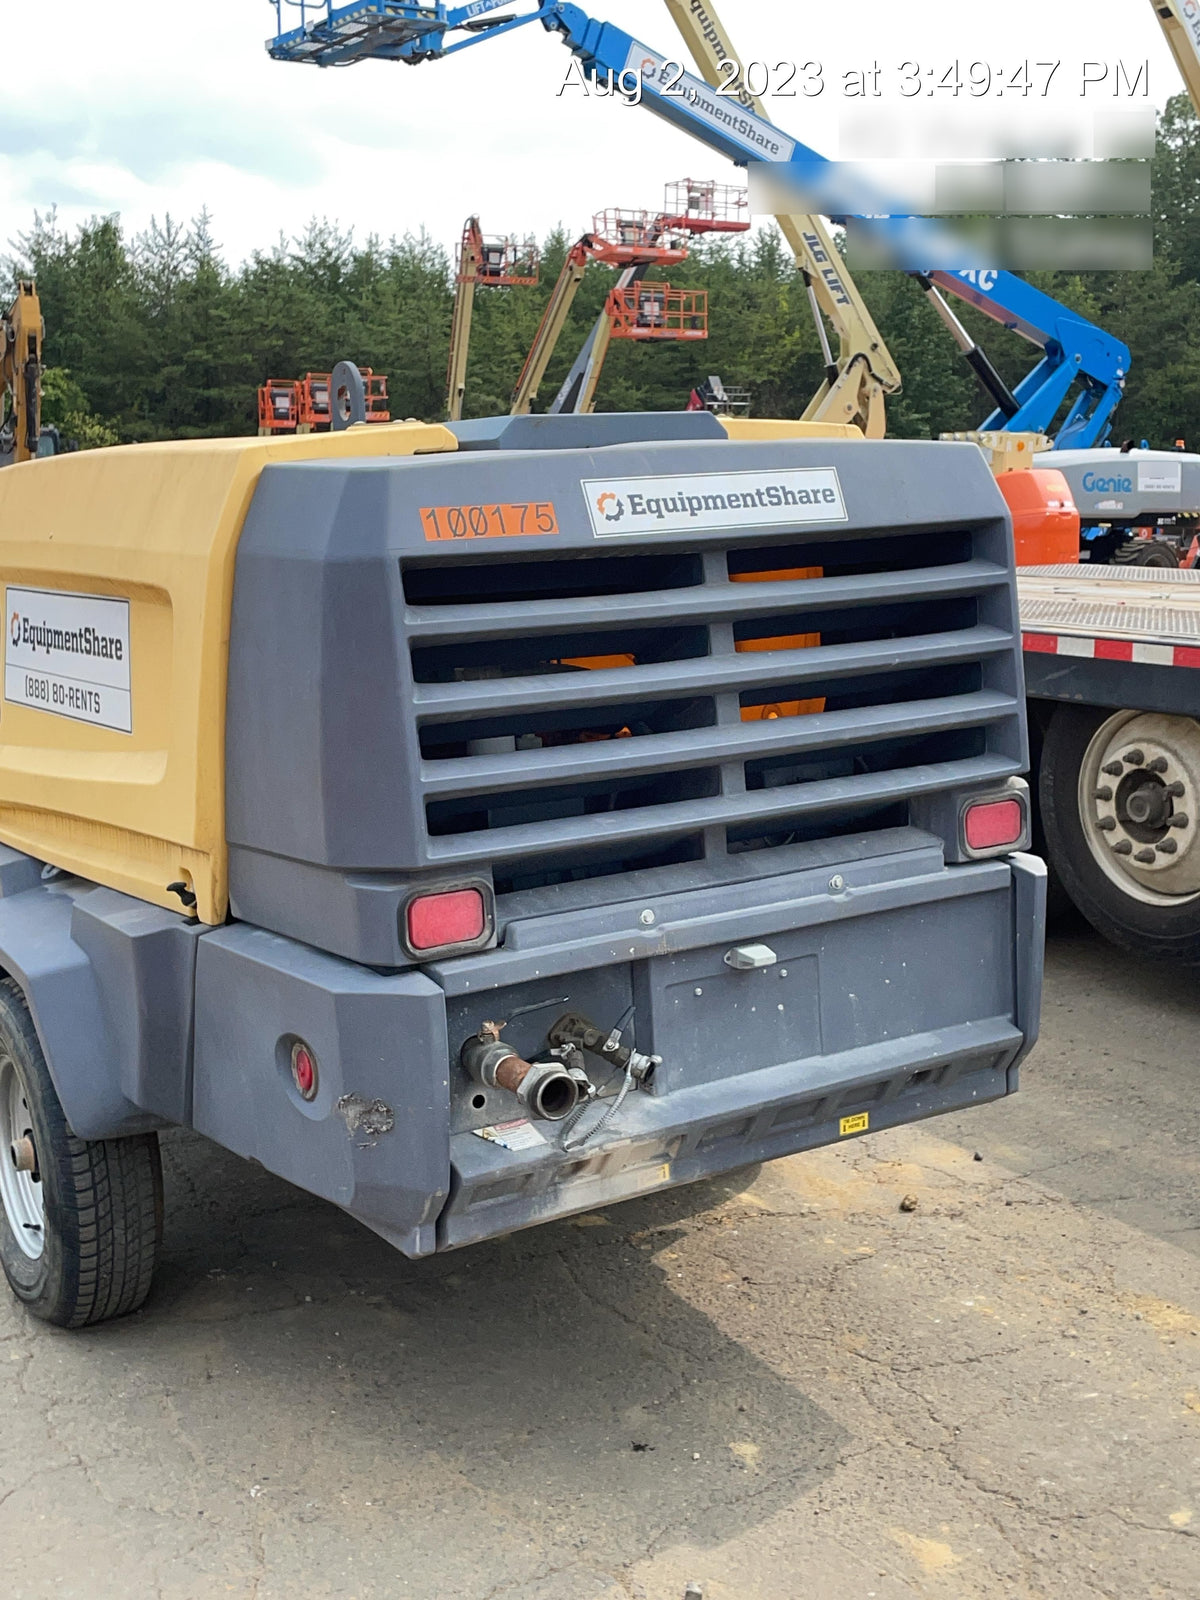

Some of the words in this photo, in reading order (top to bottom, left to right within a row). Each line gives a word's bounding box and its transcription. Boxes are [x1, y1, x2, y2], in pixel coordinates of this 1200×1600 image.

[803, 232, 828, 263] JLG
[821, 268, 851, 306] LIFT
[1082, 472, 1132, 493] Genie
[426, 504, 554, 538] 100175
[626, 485, 836, 520] EquipmentShare
[22, 617, 123, 661] EquipmentShare
[25, 675, 50, 703] (888)
[52, 683, 101, 714] 80-RENTS
